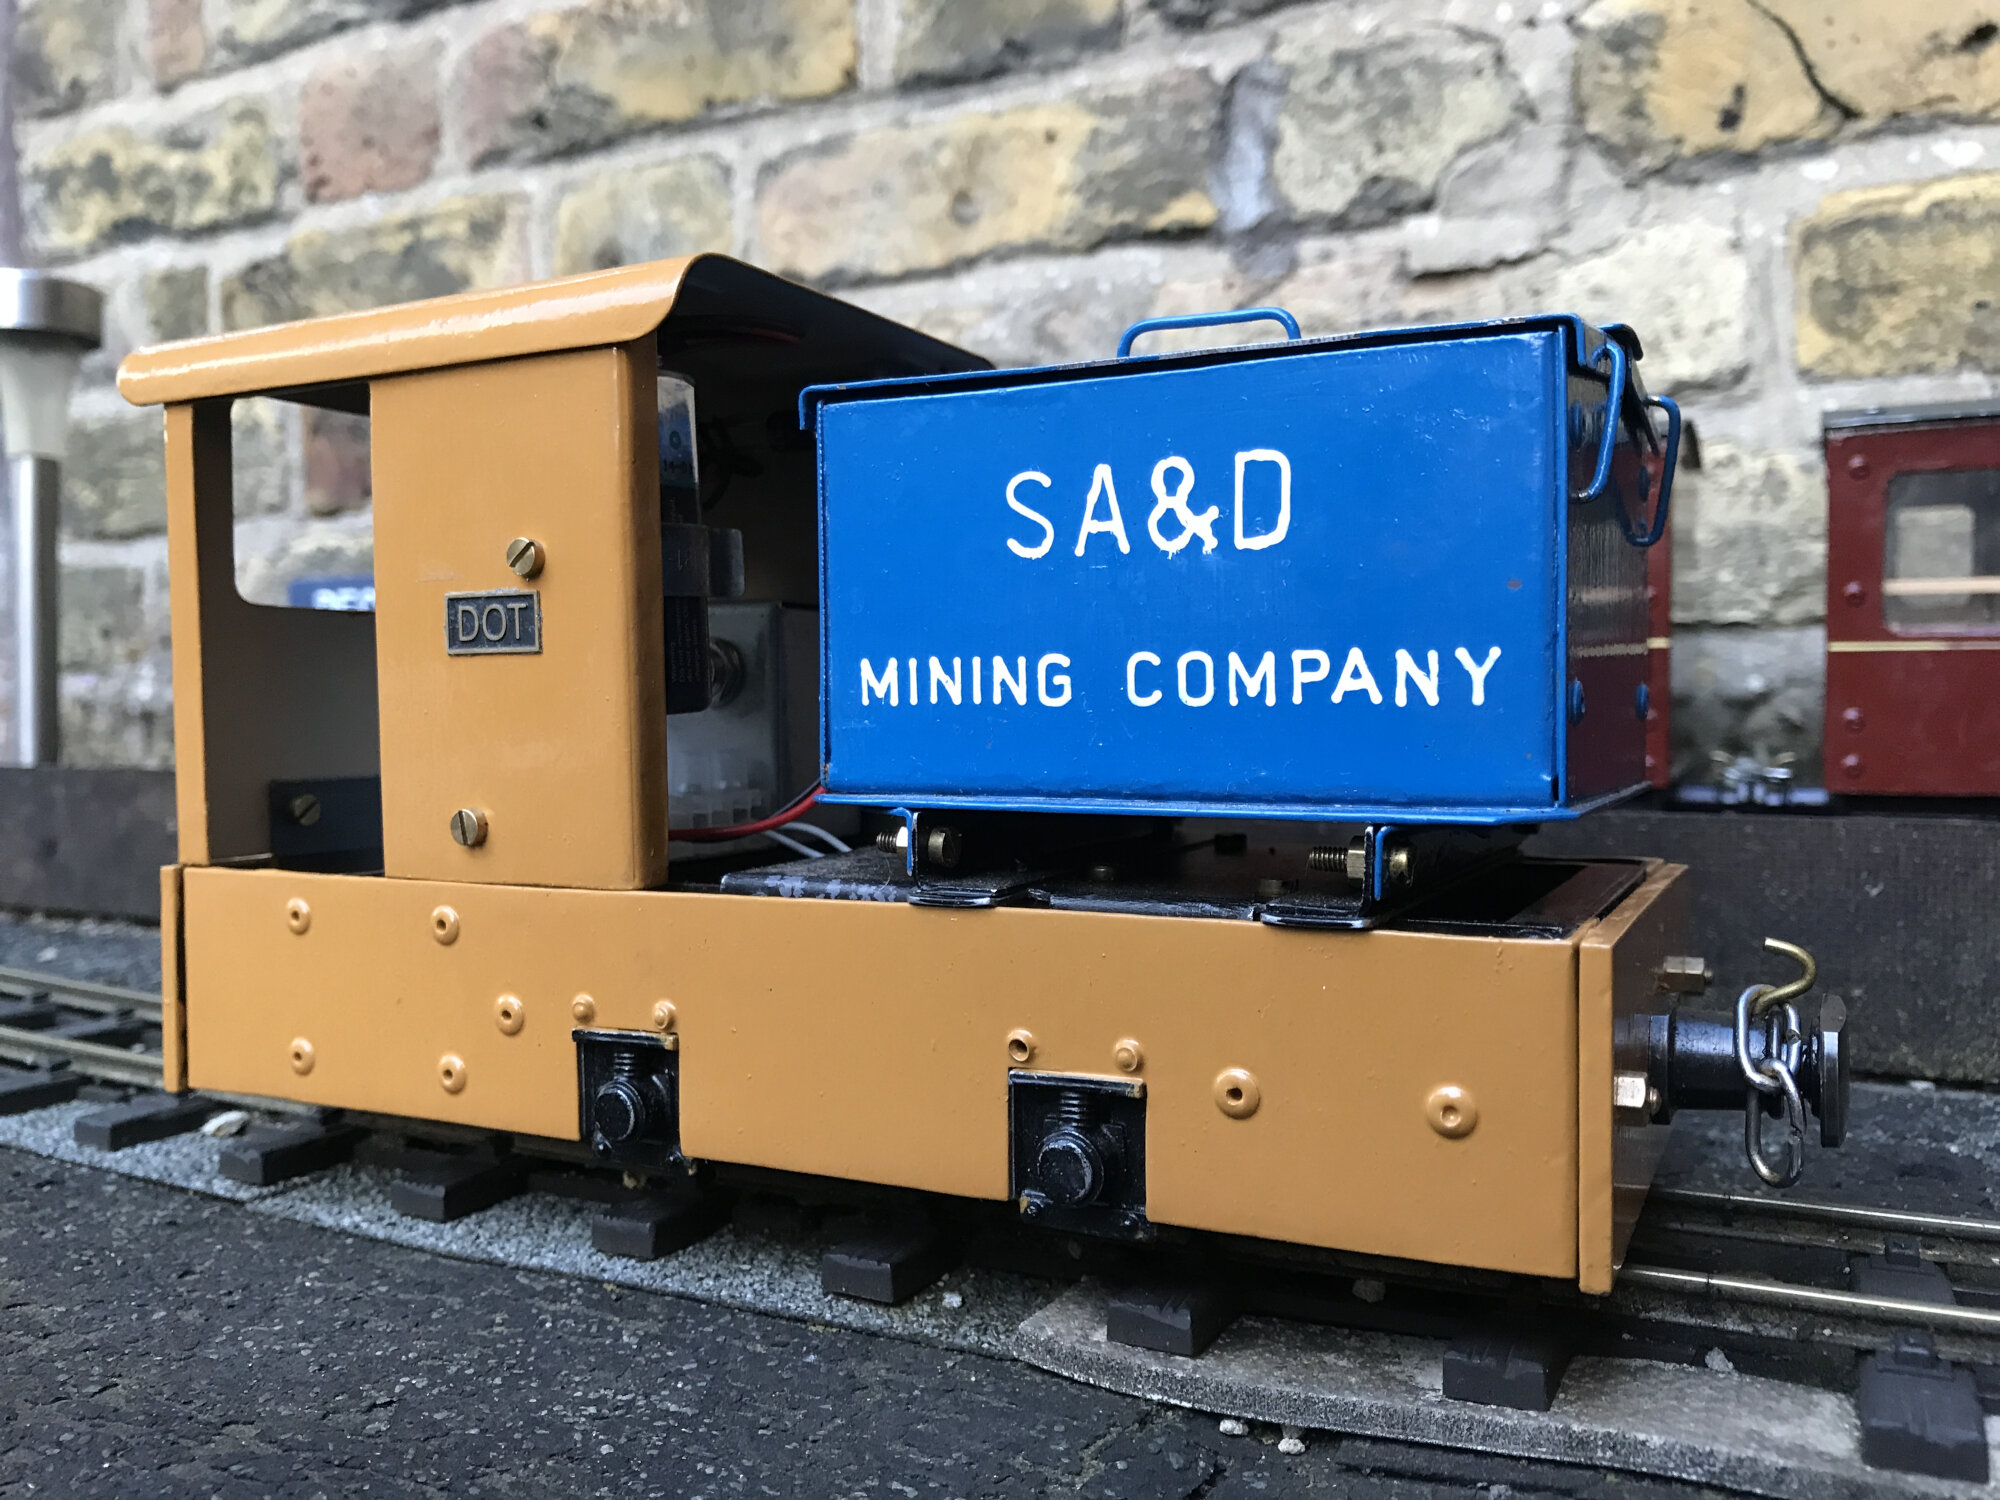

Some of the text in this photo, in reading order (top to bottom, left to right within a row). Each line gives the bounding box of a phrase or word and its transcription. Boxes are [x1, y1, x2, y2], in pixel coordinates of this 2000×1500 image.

[1004, 448, 1292, 560] SA&D
[458, 602, 528, 641] DOT
[860, 646, 1502, 708] MINING COMPANY
